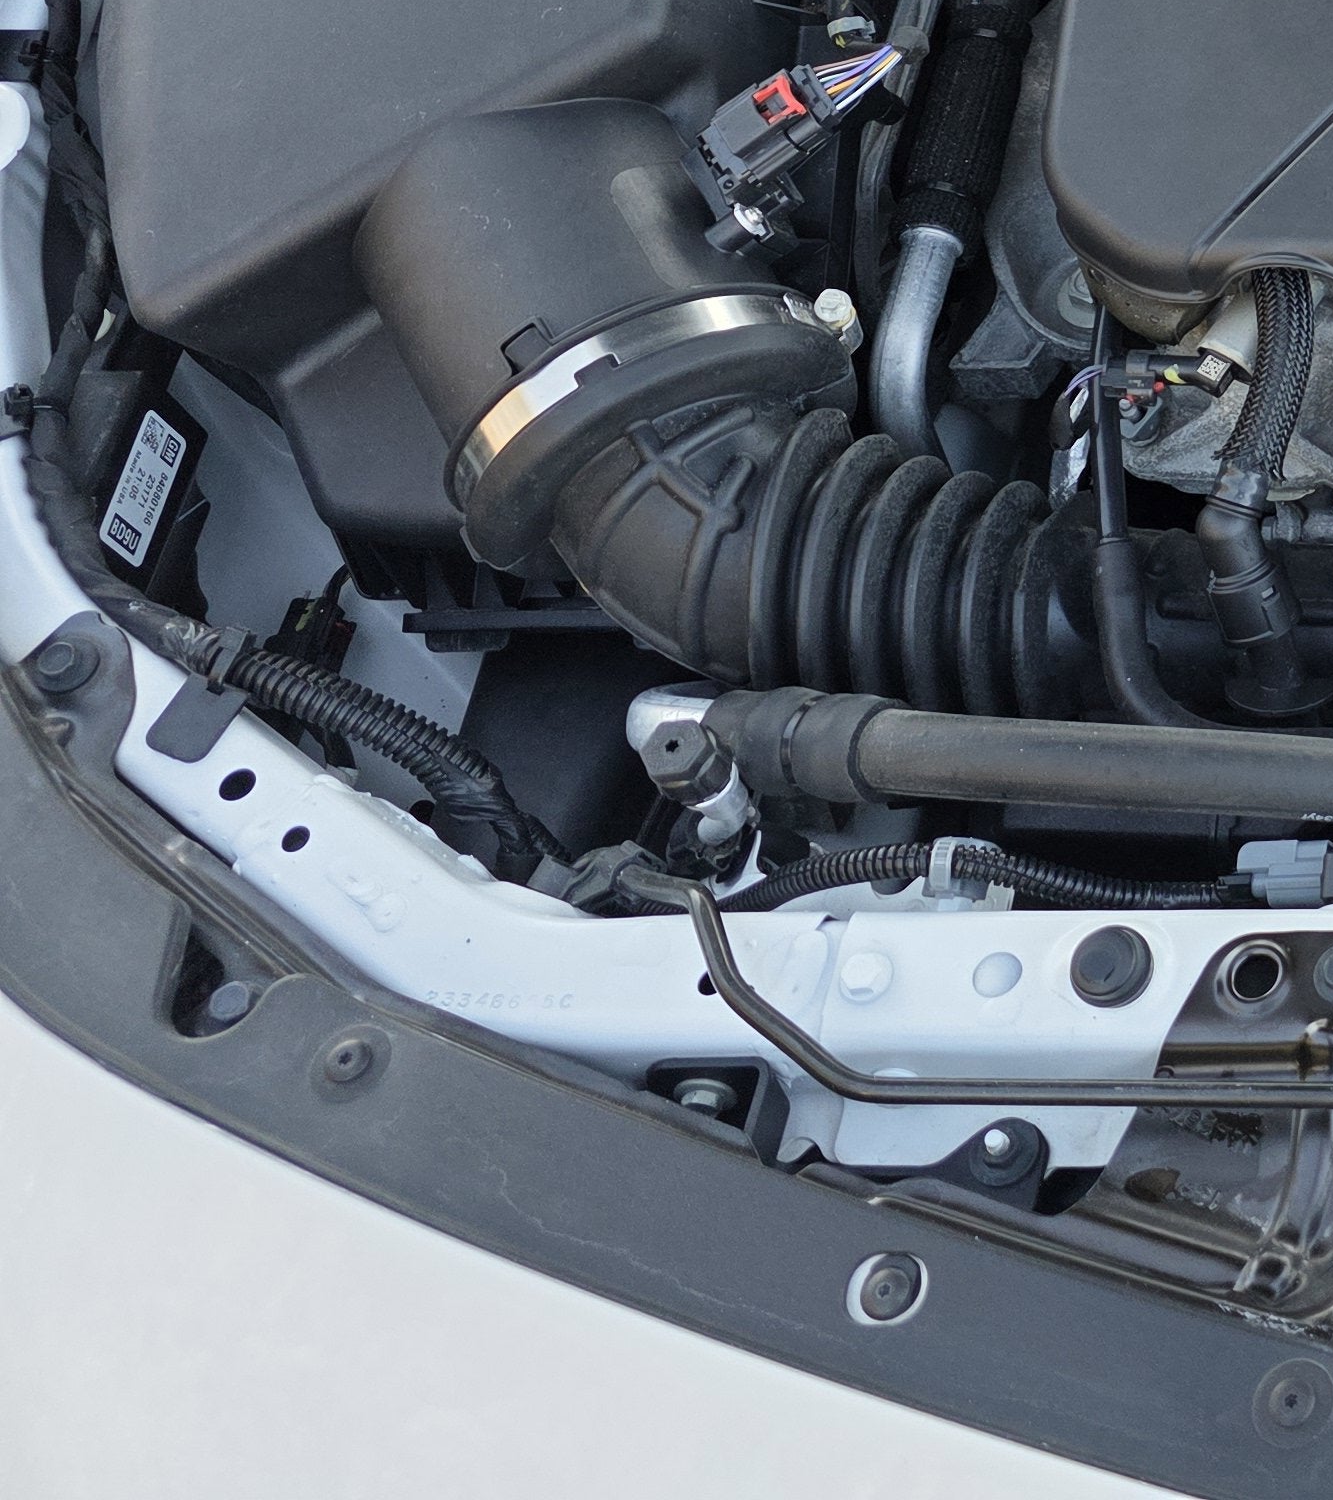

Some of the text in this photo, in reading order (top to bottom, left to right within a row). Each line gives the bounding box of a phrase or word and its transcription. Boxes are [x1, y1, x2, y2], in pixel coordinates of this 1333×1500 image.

[164, 438, 180, 466] GM
[116, 486, 128, 505] USA
[111, 520, 139, 551] BD9U
